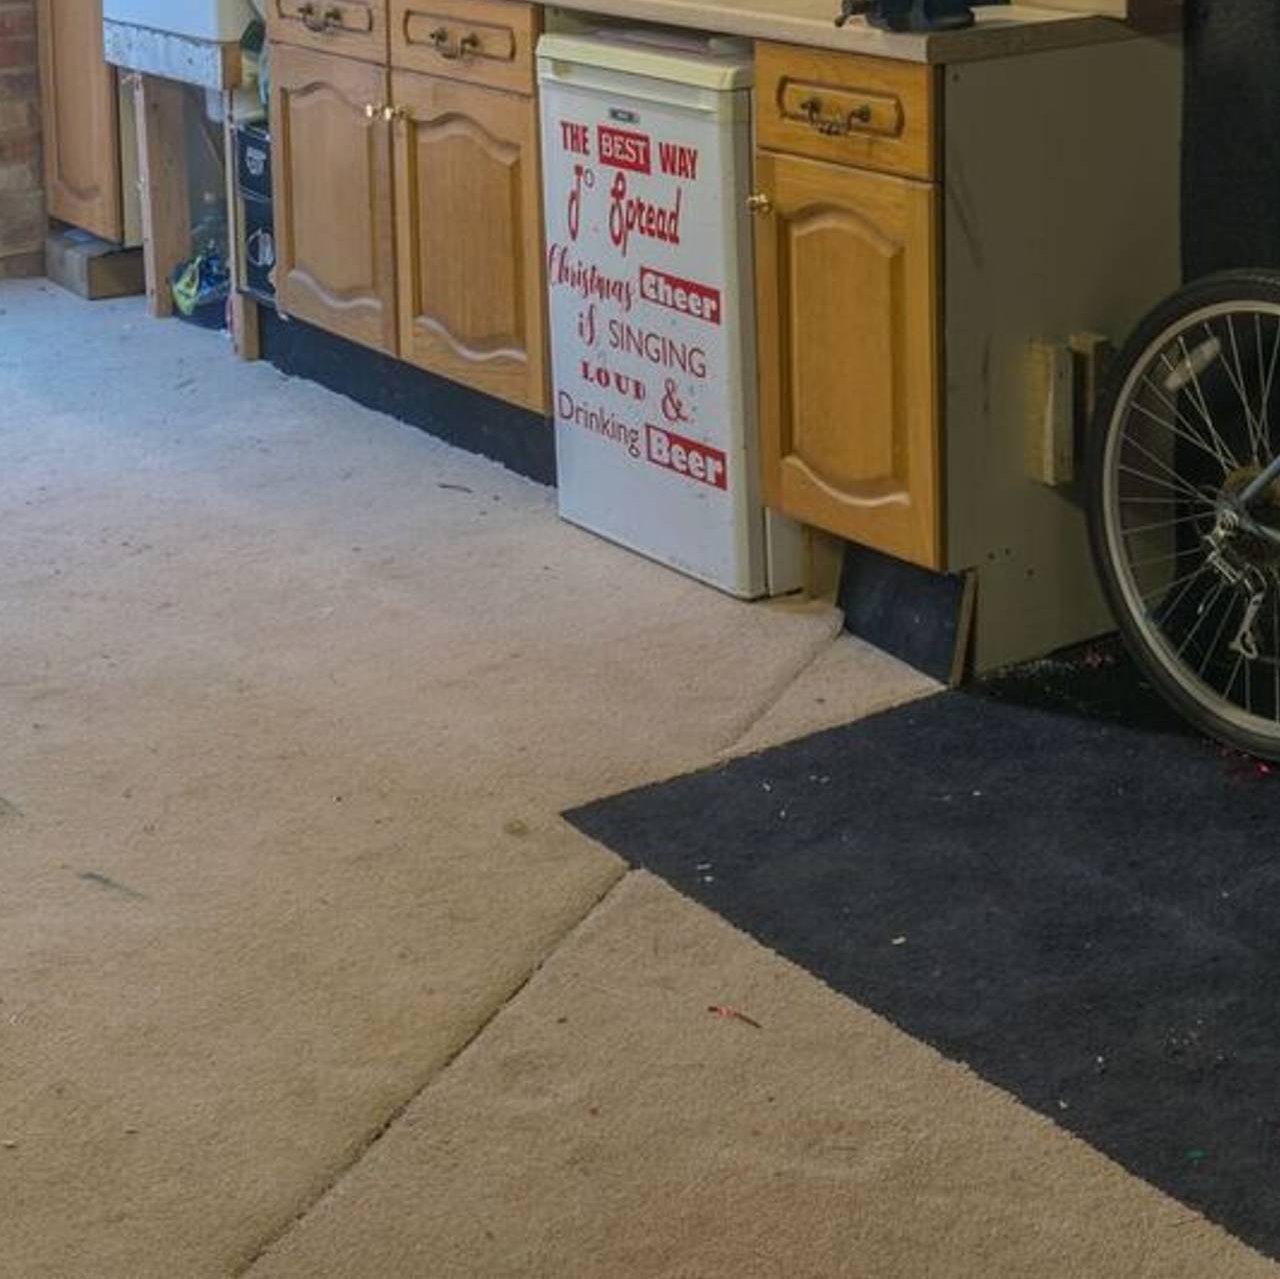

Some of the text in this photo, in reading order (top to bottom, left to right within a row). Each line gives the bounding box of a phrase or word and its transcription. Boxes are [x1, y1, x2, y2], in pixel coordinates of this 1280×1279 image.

[560, 120, 699, 181] THE BEST WAY
[640, 271, 720, 320] Cheer
[608, 319, 708, 379] SINGING
[580, 360, 647, 401] LOUD
[558, 390, 726, 487] Drinking Beer
